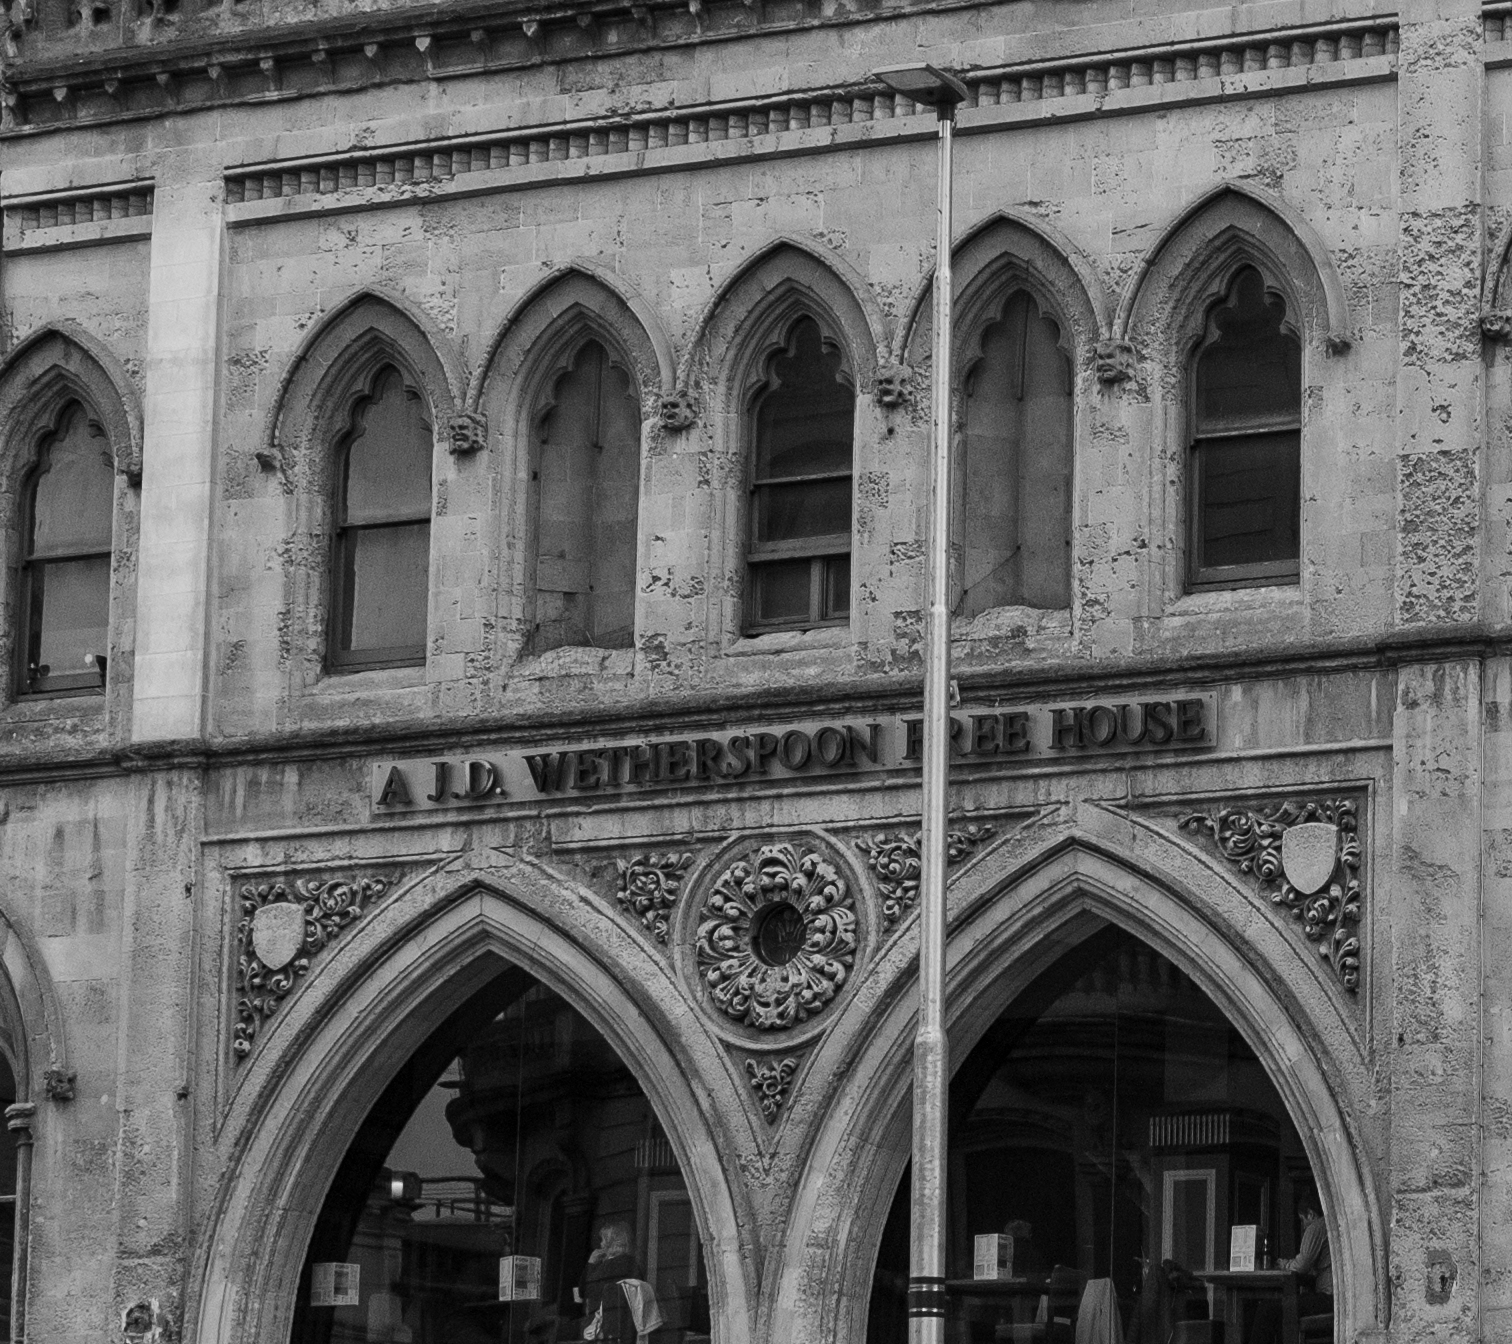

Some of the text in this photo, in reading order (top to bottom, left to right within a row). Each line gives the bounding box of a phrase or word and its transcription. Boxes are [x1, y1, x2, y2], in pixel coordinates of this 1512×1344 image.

[377, 766, 411, 805] A
[427, 760, 503, 802] J.D.
[522, 724, 882, 793] WETHERSPOON
[1048, 698, 1206, 750] HOUSE
